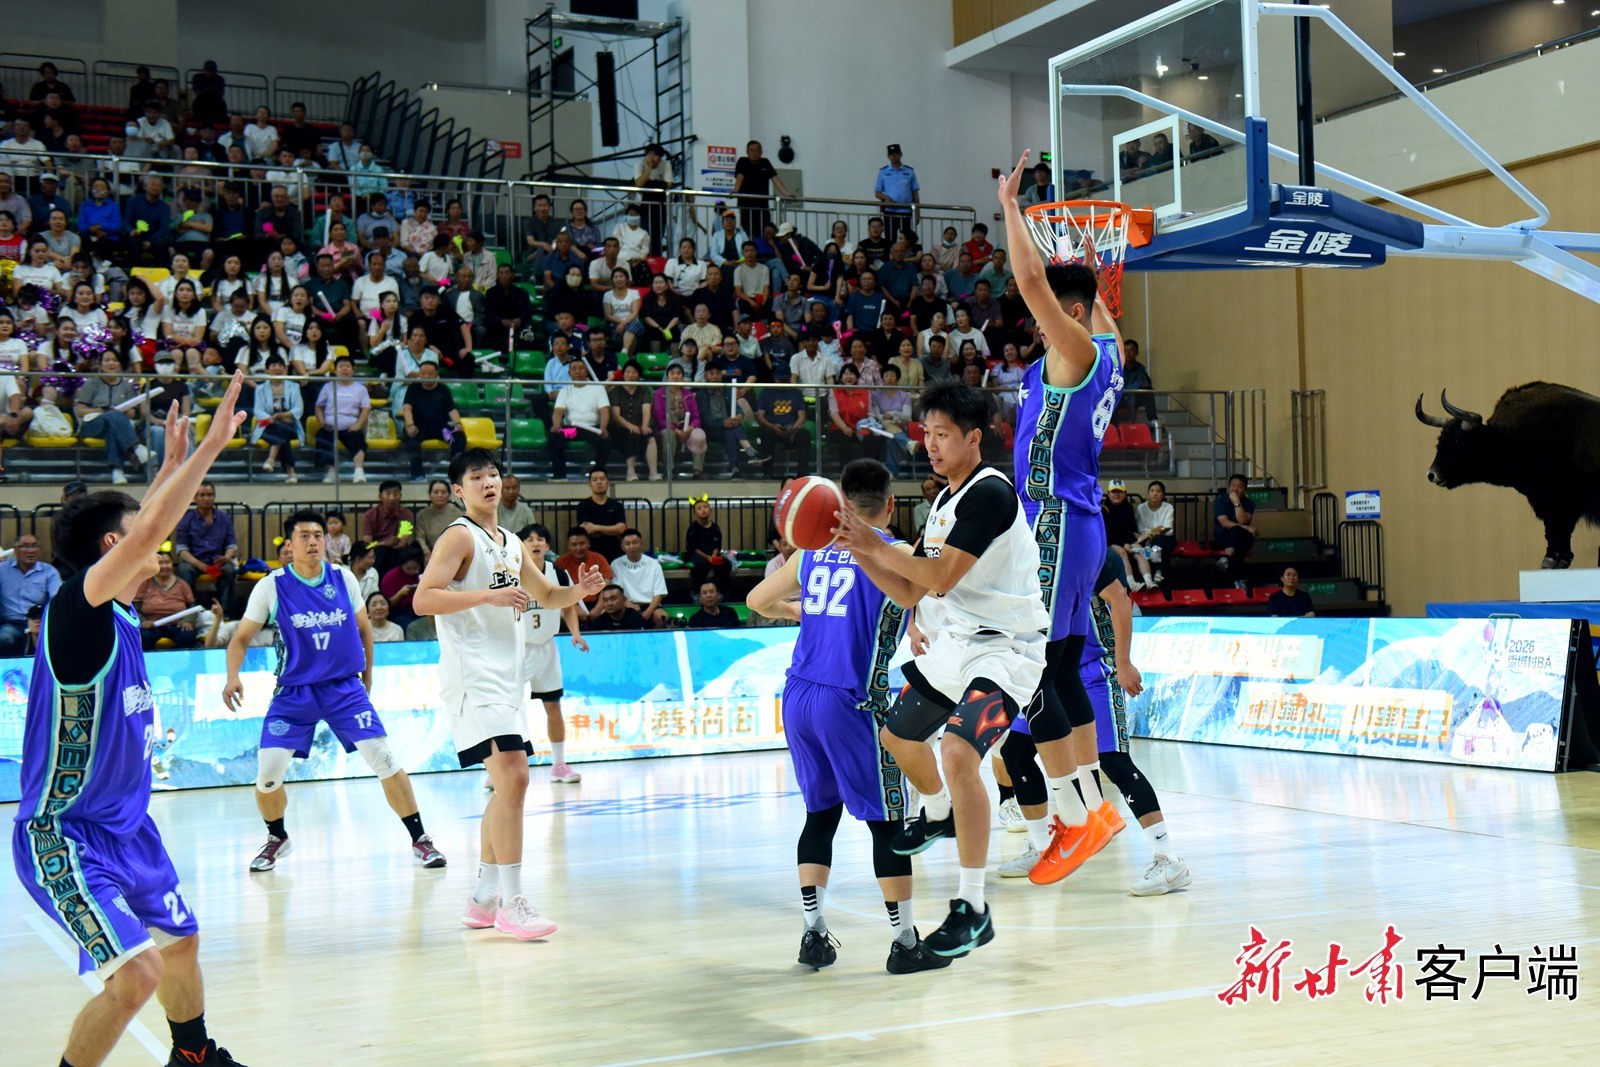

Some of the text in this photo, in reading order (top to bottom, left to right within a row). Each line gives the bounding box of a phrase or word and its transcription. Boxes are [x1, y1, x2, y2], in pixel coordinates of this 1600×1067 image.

[1285, 191, 1330, 208] 金陵
[1244, 229, 1372, 258] 金陵
[803, 566, 855, 617] 92
[532, 614, 541, 629] 3
[312, 632, 330, 650] 17
[1508, 639, 1535, 654] 2026
[353, 710, 372, 729] 17
